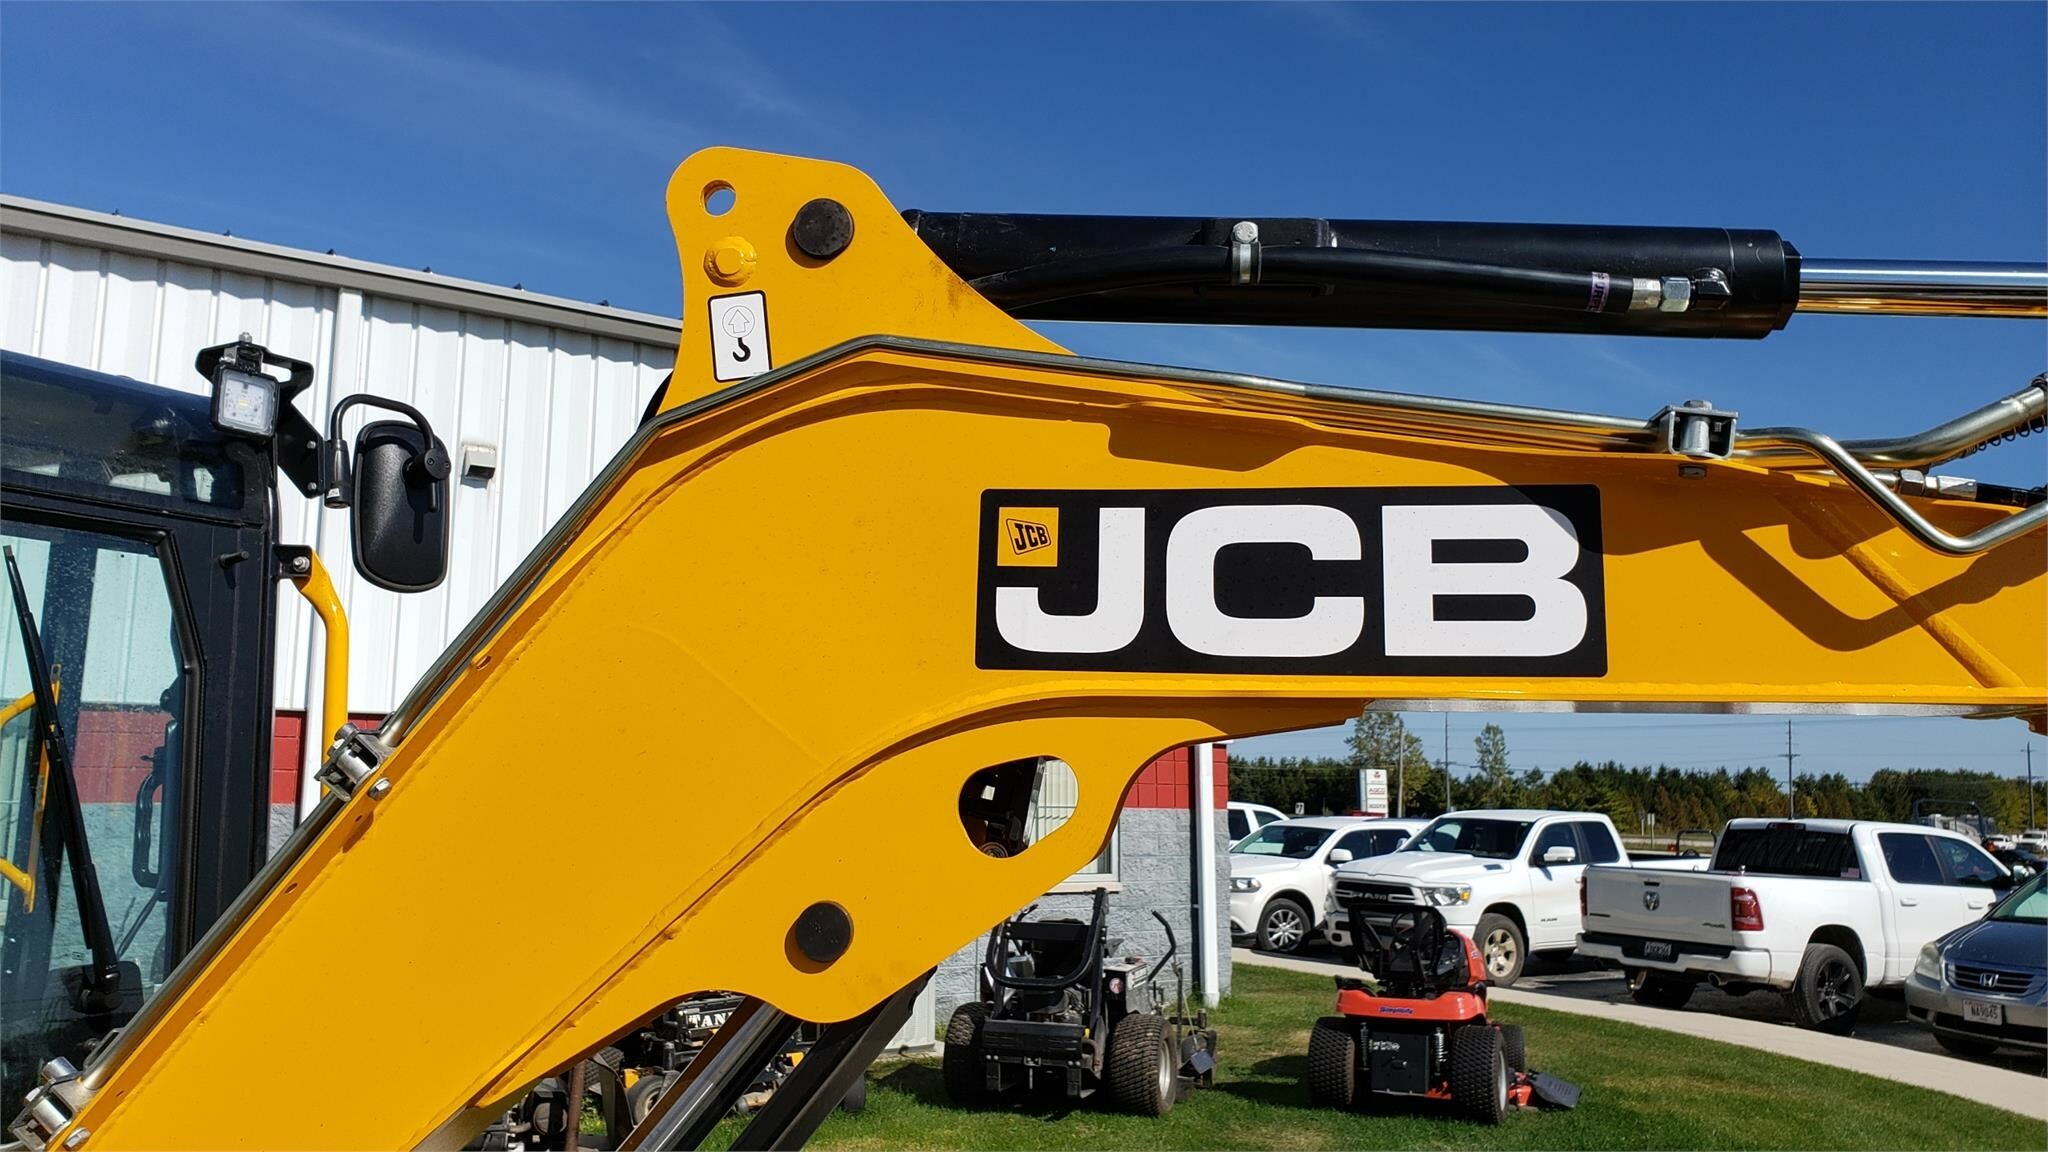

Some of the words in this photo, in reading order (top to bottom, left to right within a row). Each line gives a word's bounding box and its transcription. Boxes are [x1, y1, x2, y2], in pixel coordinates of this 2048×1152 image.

[1013, 522, 1049, 551] JCB
[996, 504, 1588, 657] JCB
[688, 1011, 734, 1028] TAN
